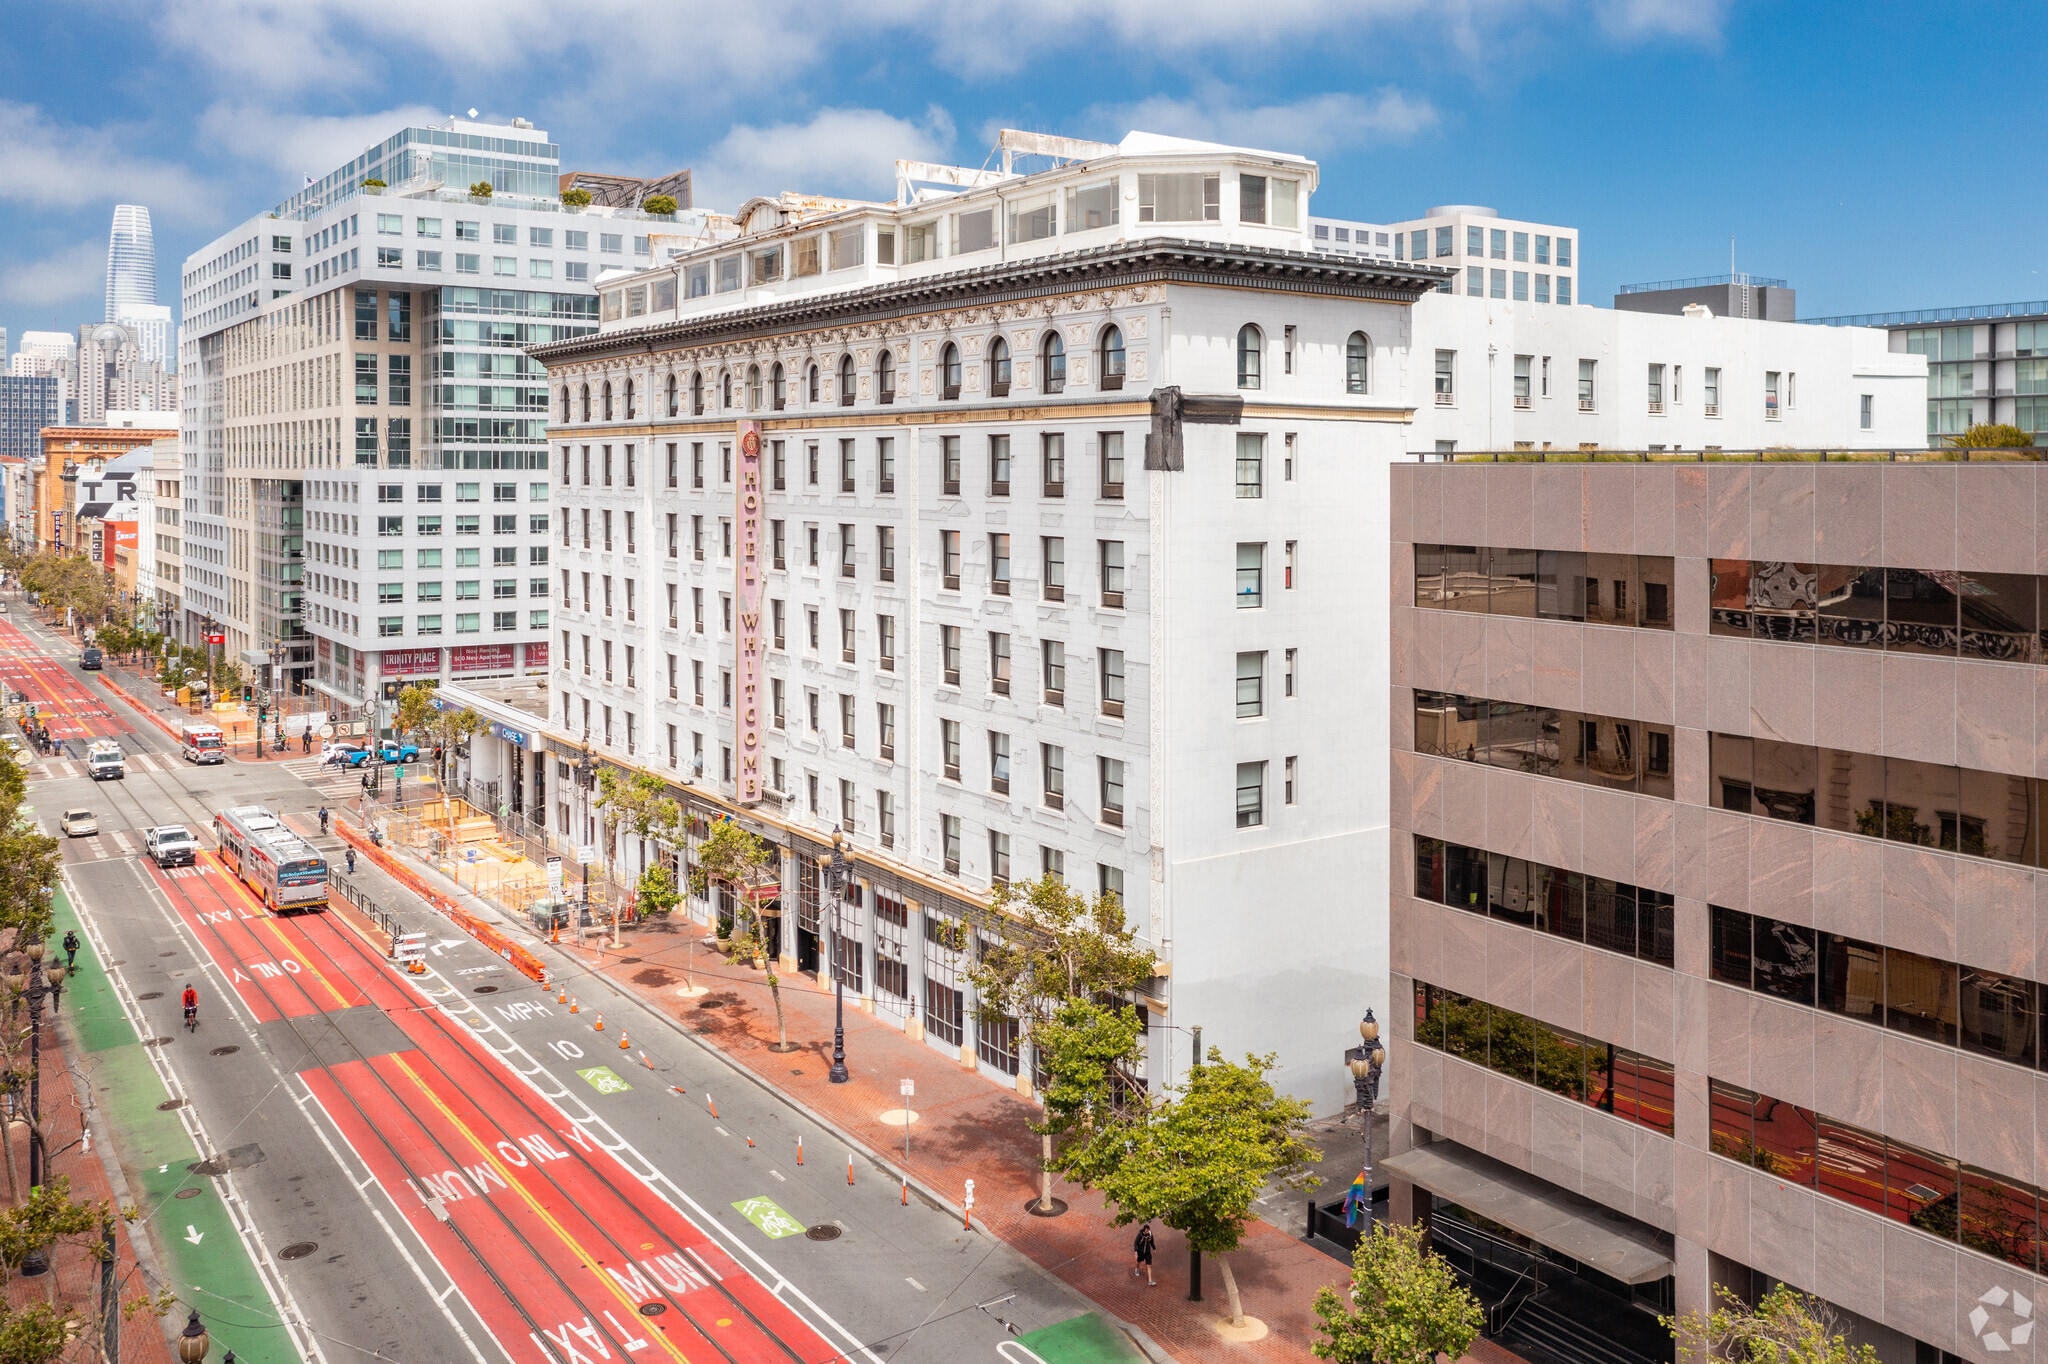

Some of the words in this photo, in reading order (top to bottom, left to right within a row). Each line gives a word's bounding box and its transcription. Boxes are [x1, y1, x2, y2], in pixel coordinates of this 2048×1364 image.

[744, 471, 758, 581] HOTEL
[385, 652, 412, 665] TRINITY
[414, 651, 436, 663] PLACE
[479, 653, 511, 662] Apartments
[742, 613, 759, 793] WHITCOMB
[196, 907, 252, 926] TAXI
[233, 958, 301, 984] ONLY
[454, 964, 503, 976] ZONE
[494, 1000, 553, 1023] MPH
[547, 1040, 584, 1061] 10
[496, 1126, 593, 1168] ONLY
[405, 1161, 508, 1205] MUNI
[604, 1247, 724, 1304] MUNI
[529, 1309, 649, 1364] TAXI
